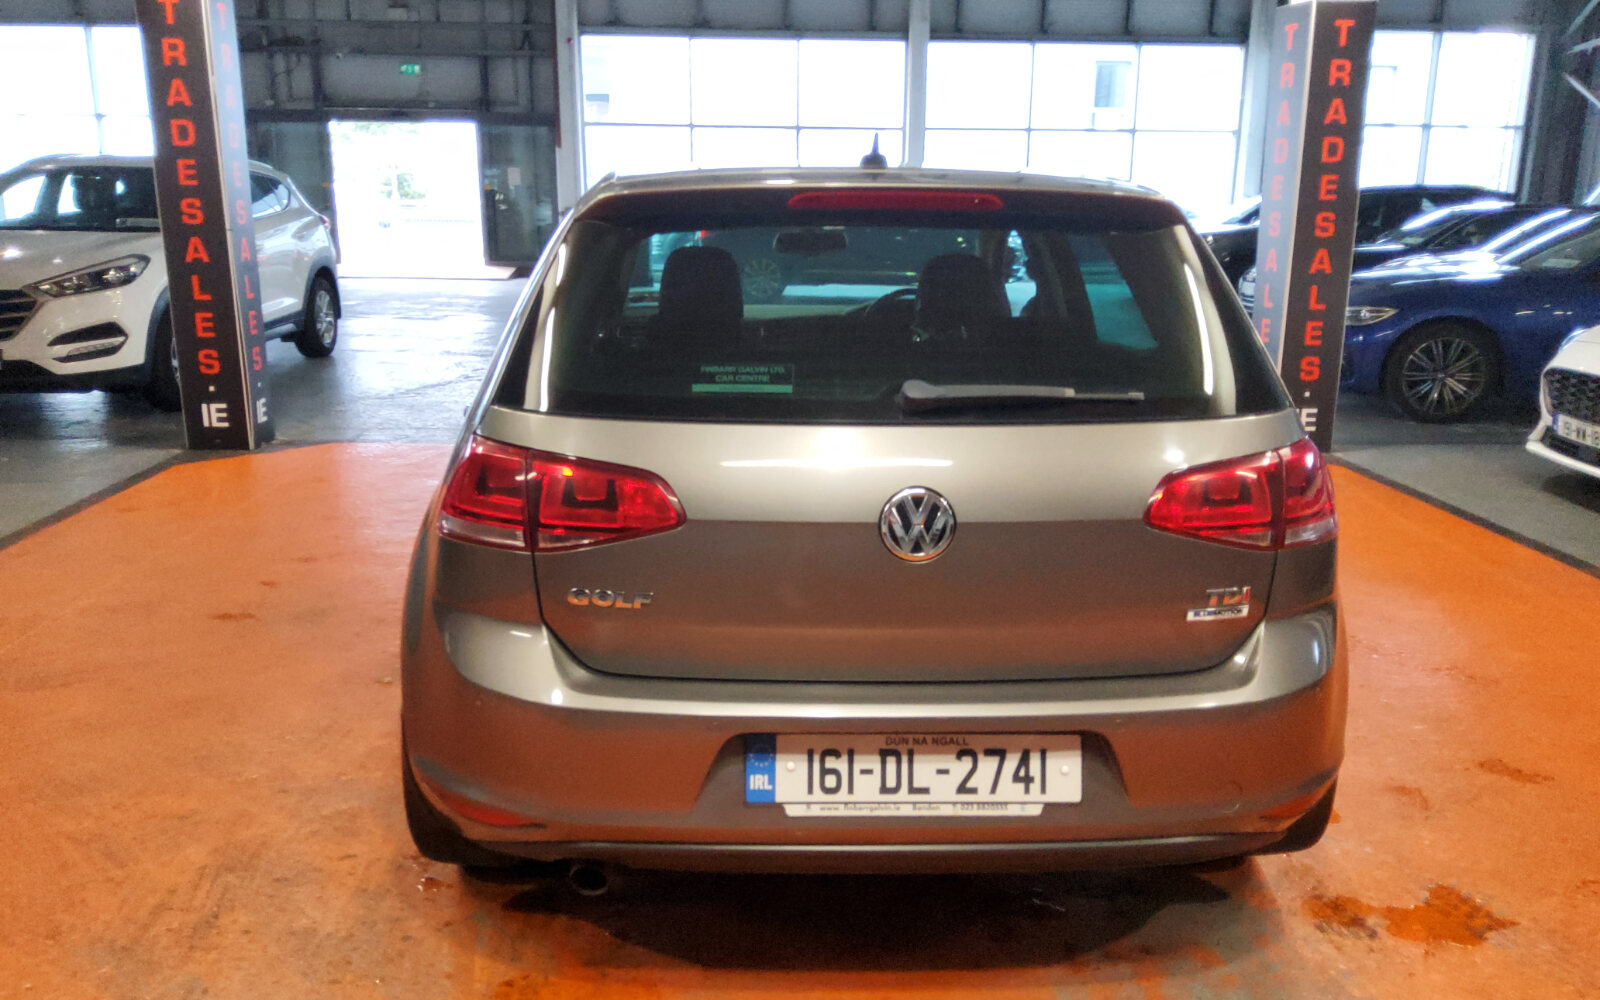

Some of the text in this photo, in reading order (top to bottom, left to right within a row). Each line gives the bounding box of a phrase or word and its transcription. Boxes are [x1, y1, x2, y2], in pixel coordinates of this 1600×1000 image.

[567, 587, 654, 608] GOLF
[1206, 586, 1251, 606] TDI
[912, 735, 928, 746] NA
[806, 748, 1048, 796] 161-DL-2741
[749, 774, 774, 791] IRL
